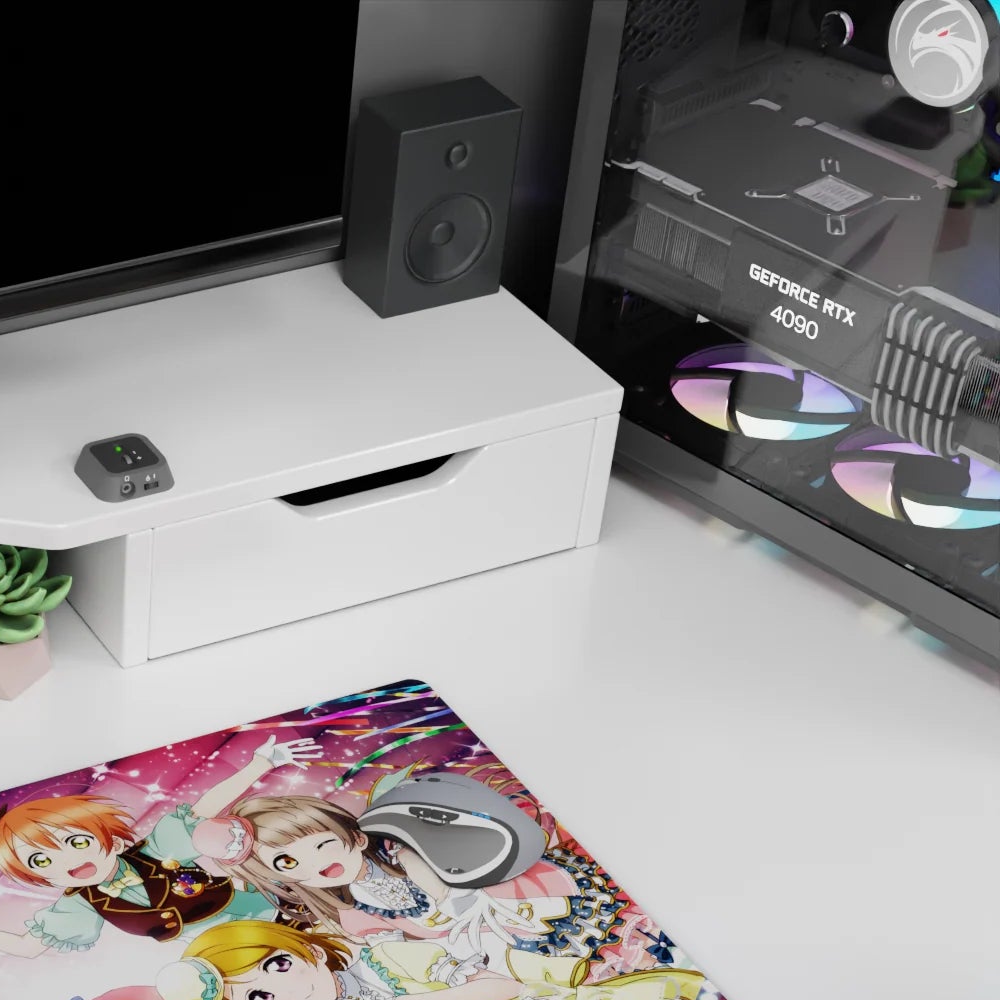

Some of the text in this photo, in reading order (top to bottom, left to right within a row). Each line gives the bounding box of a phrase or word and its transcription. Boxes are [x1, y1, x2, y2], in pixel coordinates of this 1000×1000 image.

[749, 263, 856, 327] GEFORCE RTX
[770, 305, 819, 340] 4090
